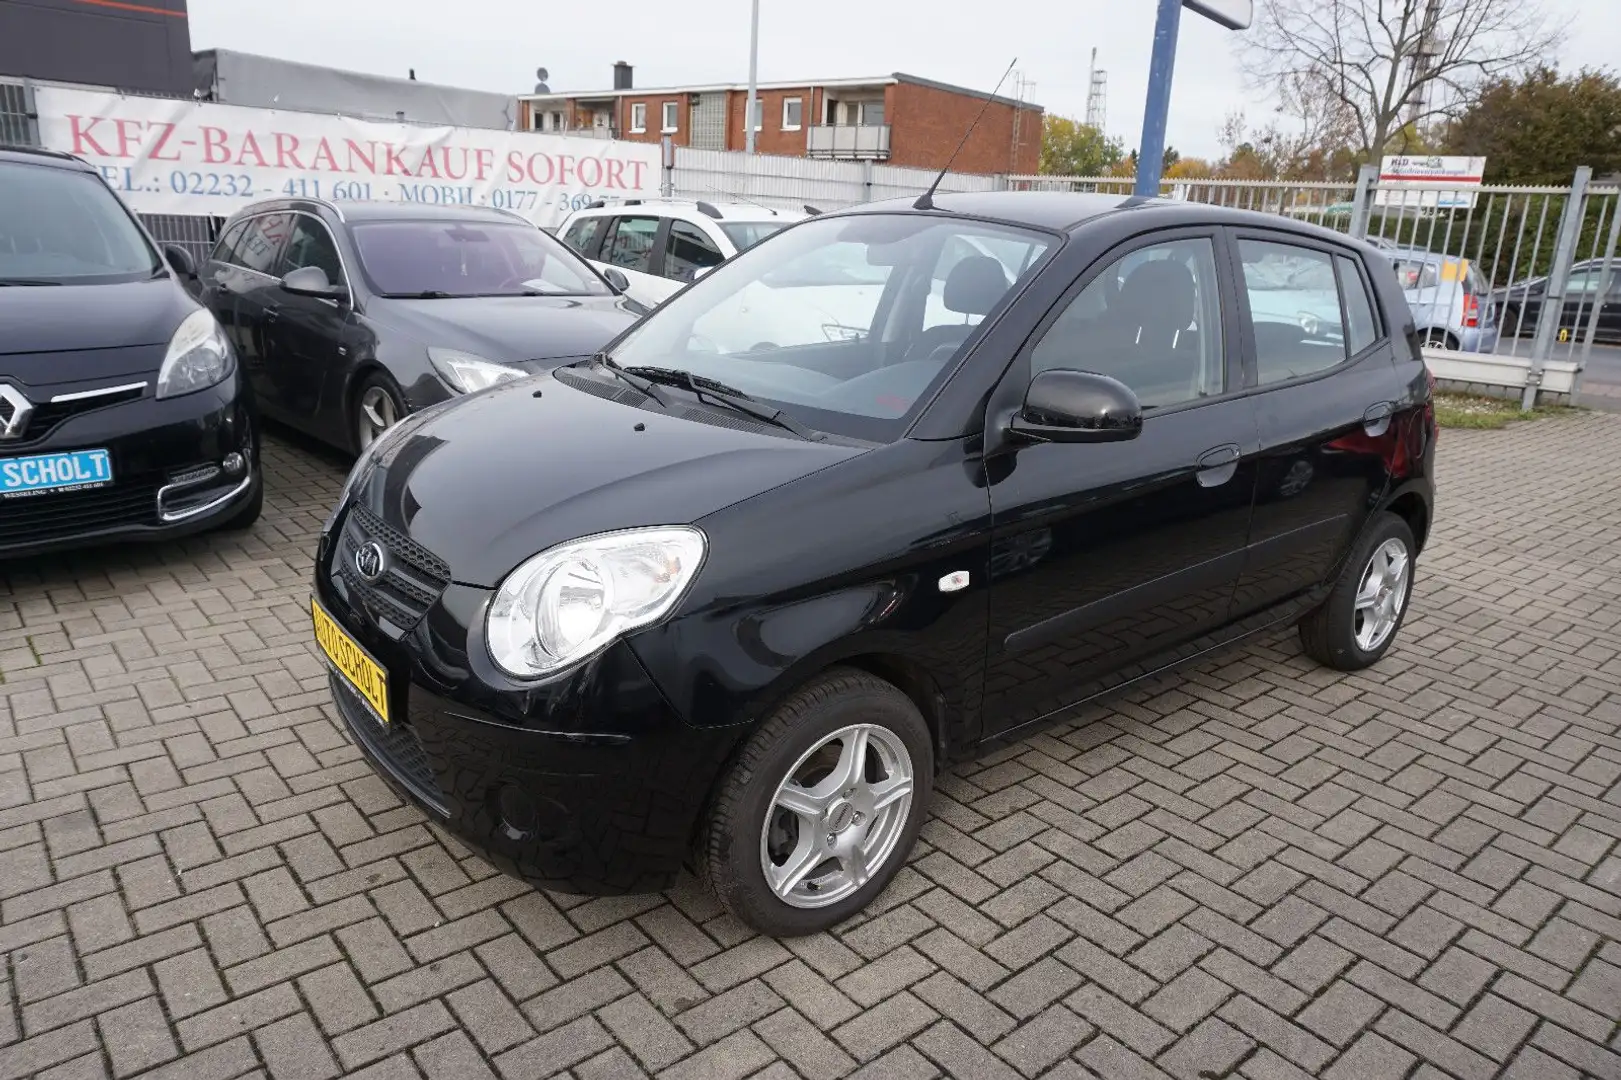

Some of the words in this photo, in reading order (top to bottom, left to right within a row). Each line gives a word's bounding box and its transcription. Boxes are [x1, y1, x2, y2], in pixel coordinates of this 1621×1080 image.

[66, 114, 494, 182] KFZ-BARANKAUF
[507, 150, 648, 191] SOFORT
[97, 165, 160, 192] EL.:
[170, 170, 254, 197] 02232
[282, 178, 320, 199] 411
[332, 180, 371, 201] 601
[492, 188, 538, 209] 0177
[2, 453, 105, 487] SCHOLT
